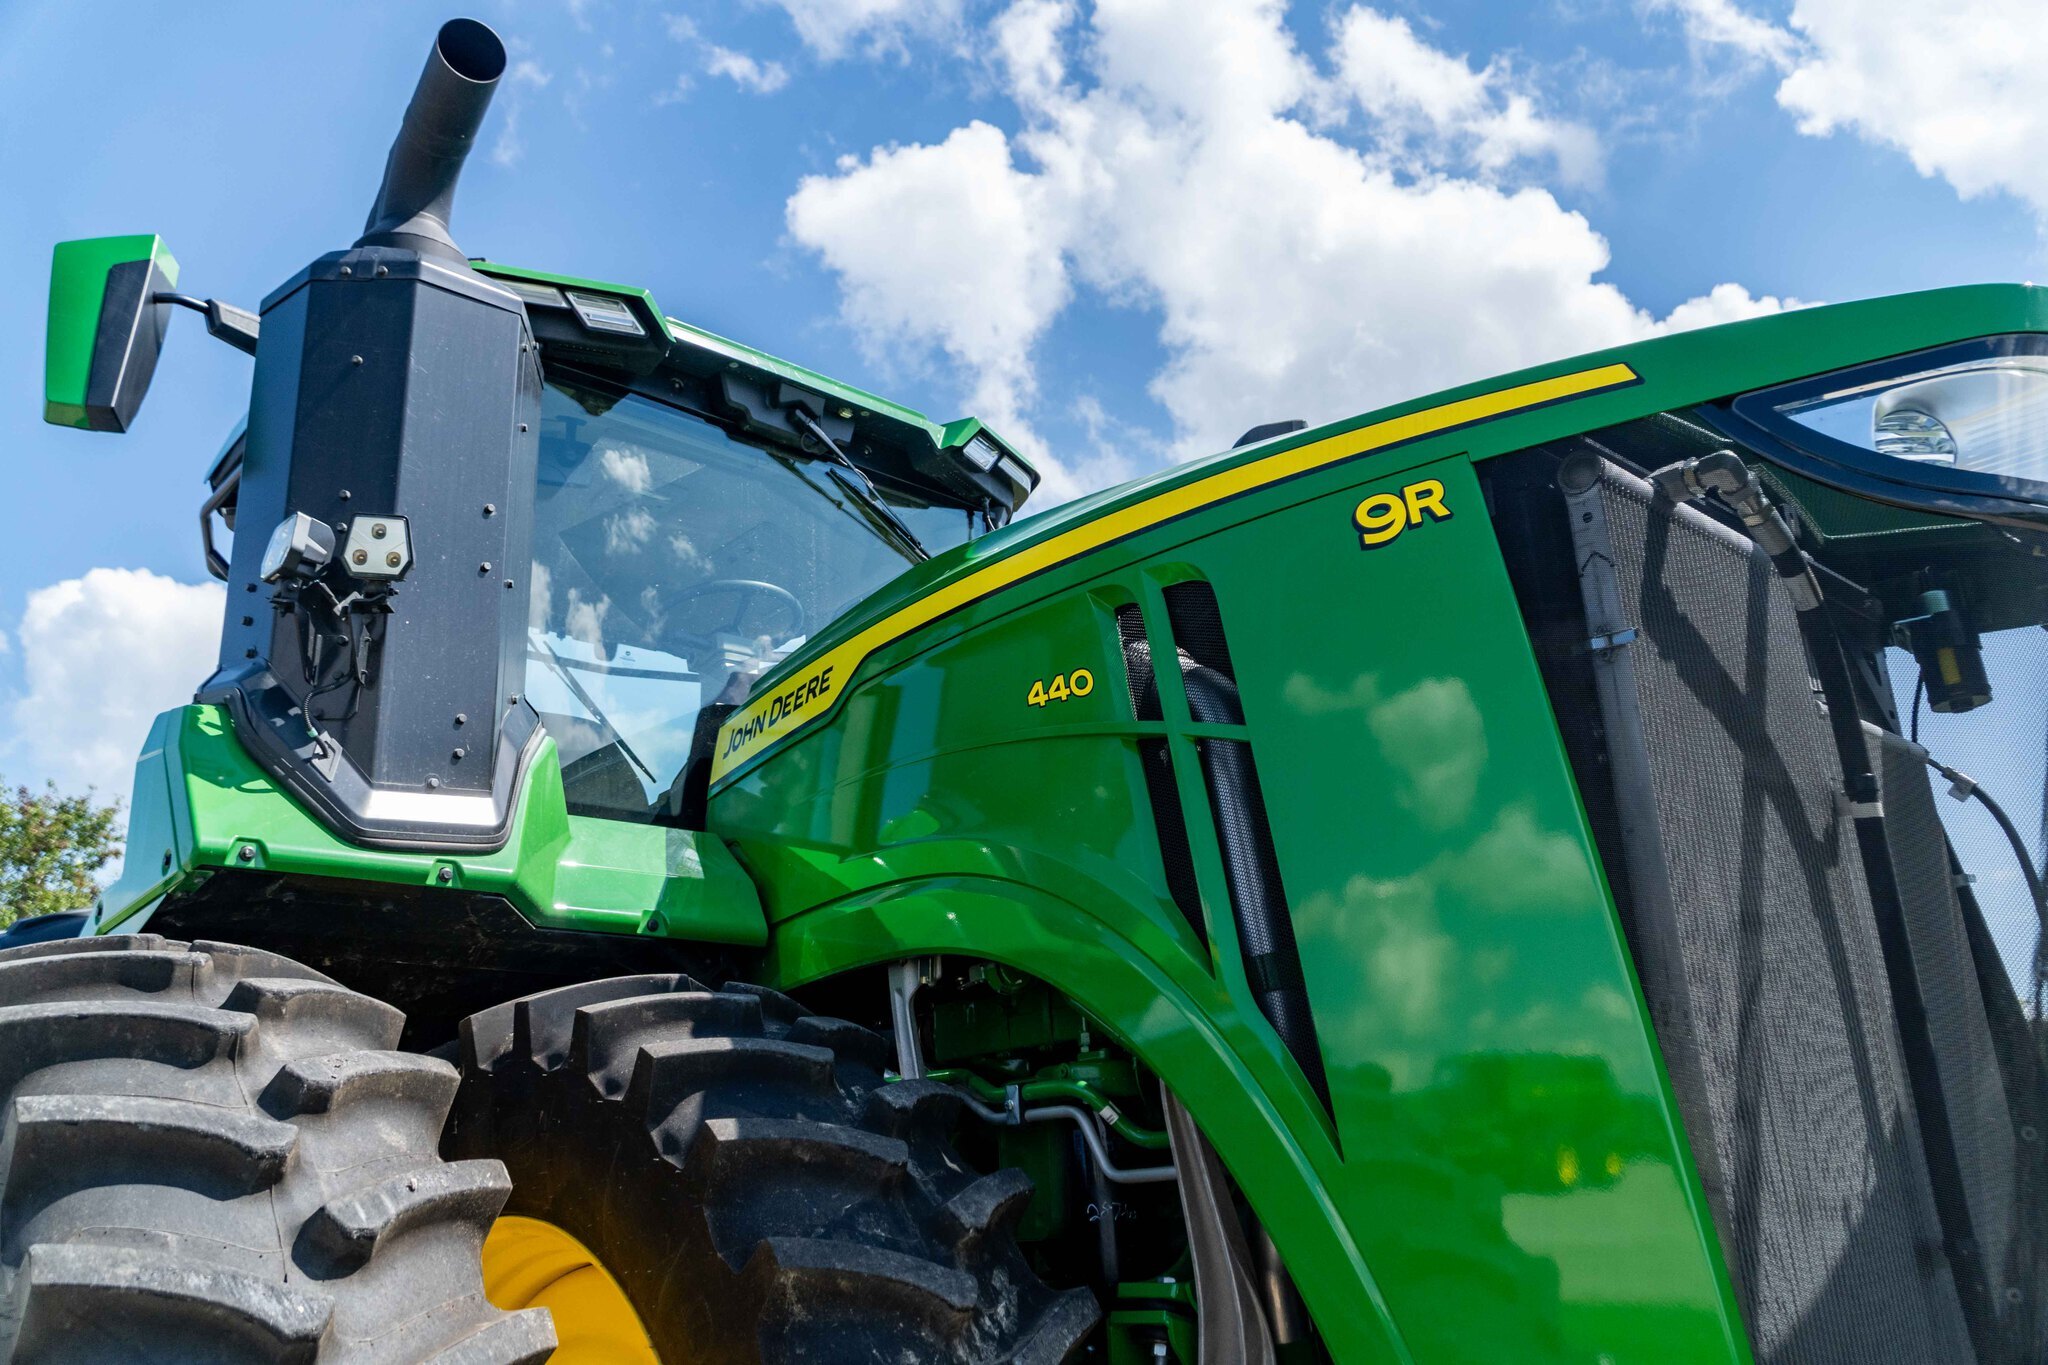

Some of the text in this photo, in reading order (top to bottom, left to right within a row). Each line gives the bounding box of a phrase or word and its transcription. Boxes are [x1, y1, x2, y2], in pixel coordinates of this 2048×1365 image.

[1352, 478, 1454, 551] 9R
[723, 665, 833, 760] JOHN DEERE
[1027, 667, 1094, 708] 440
